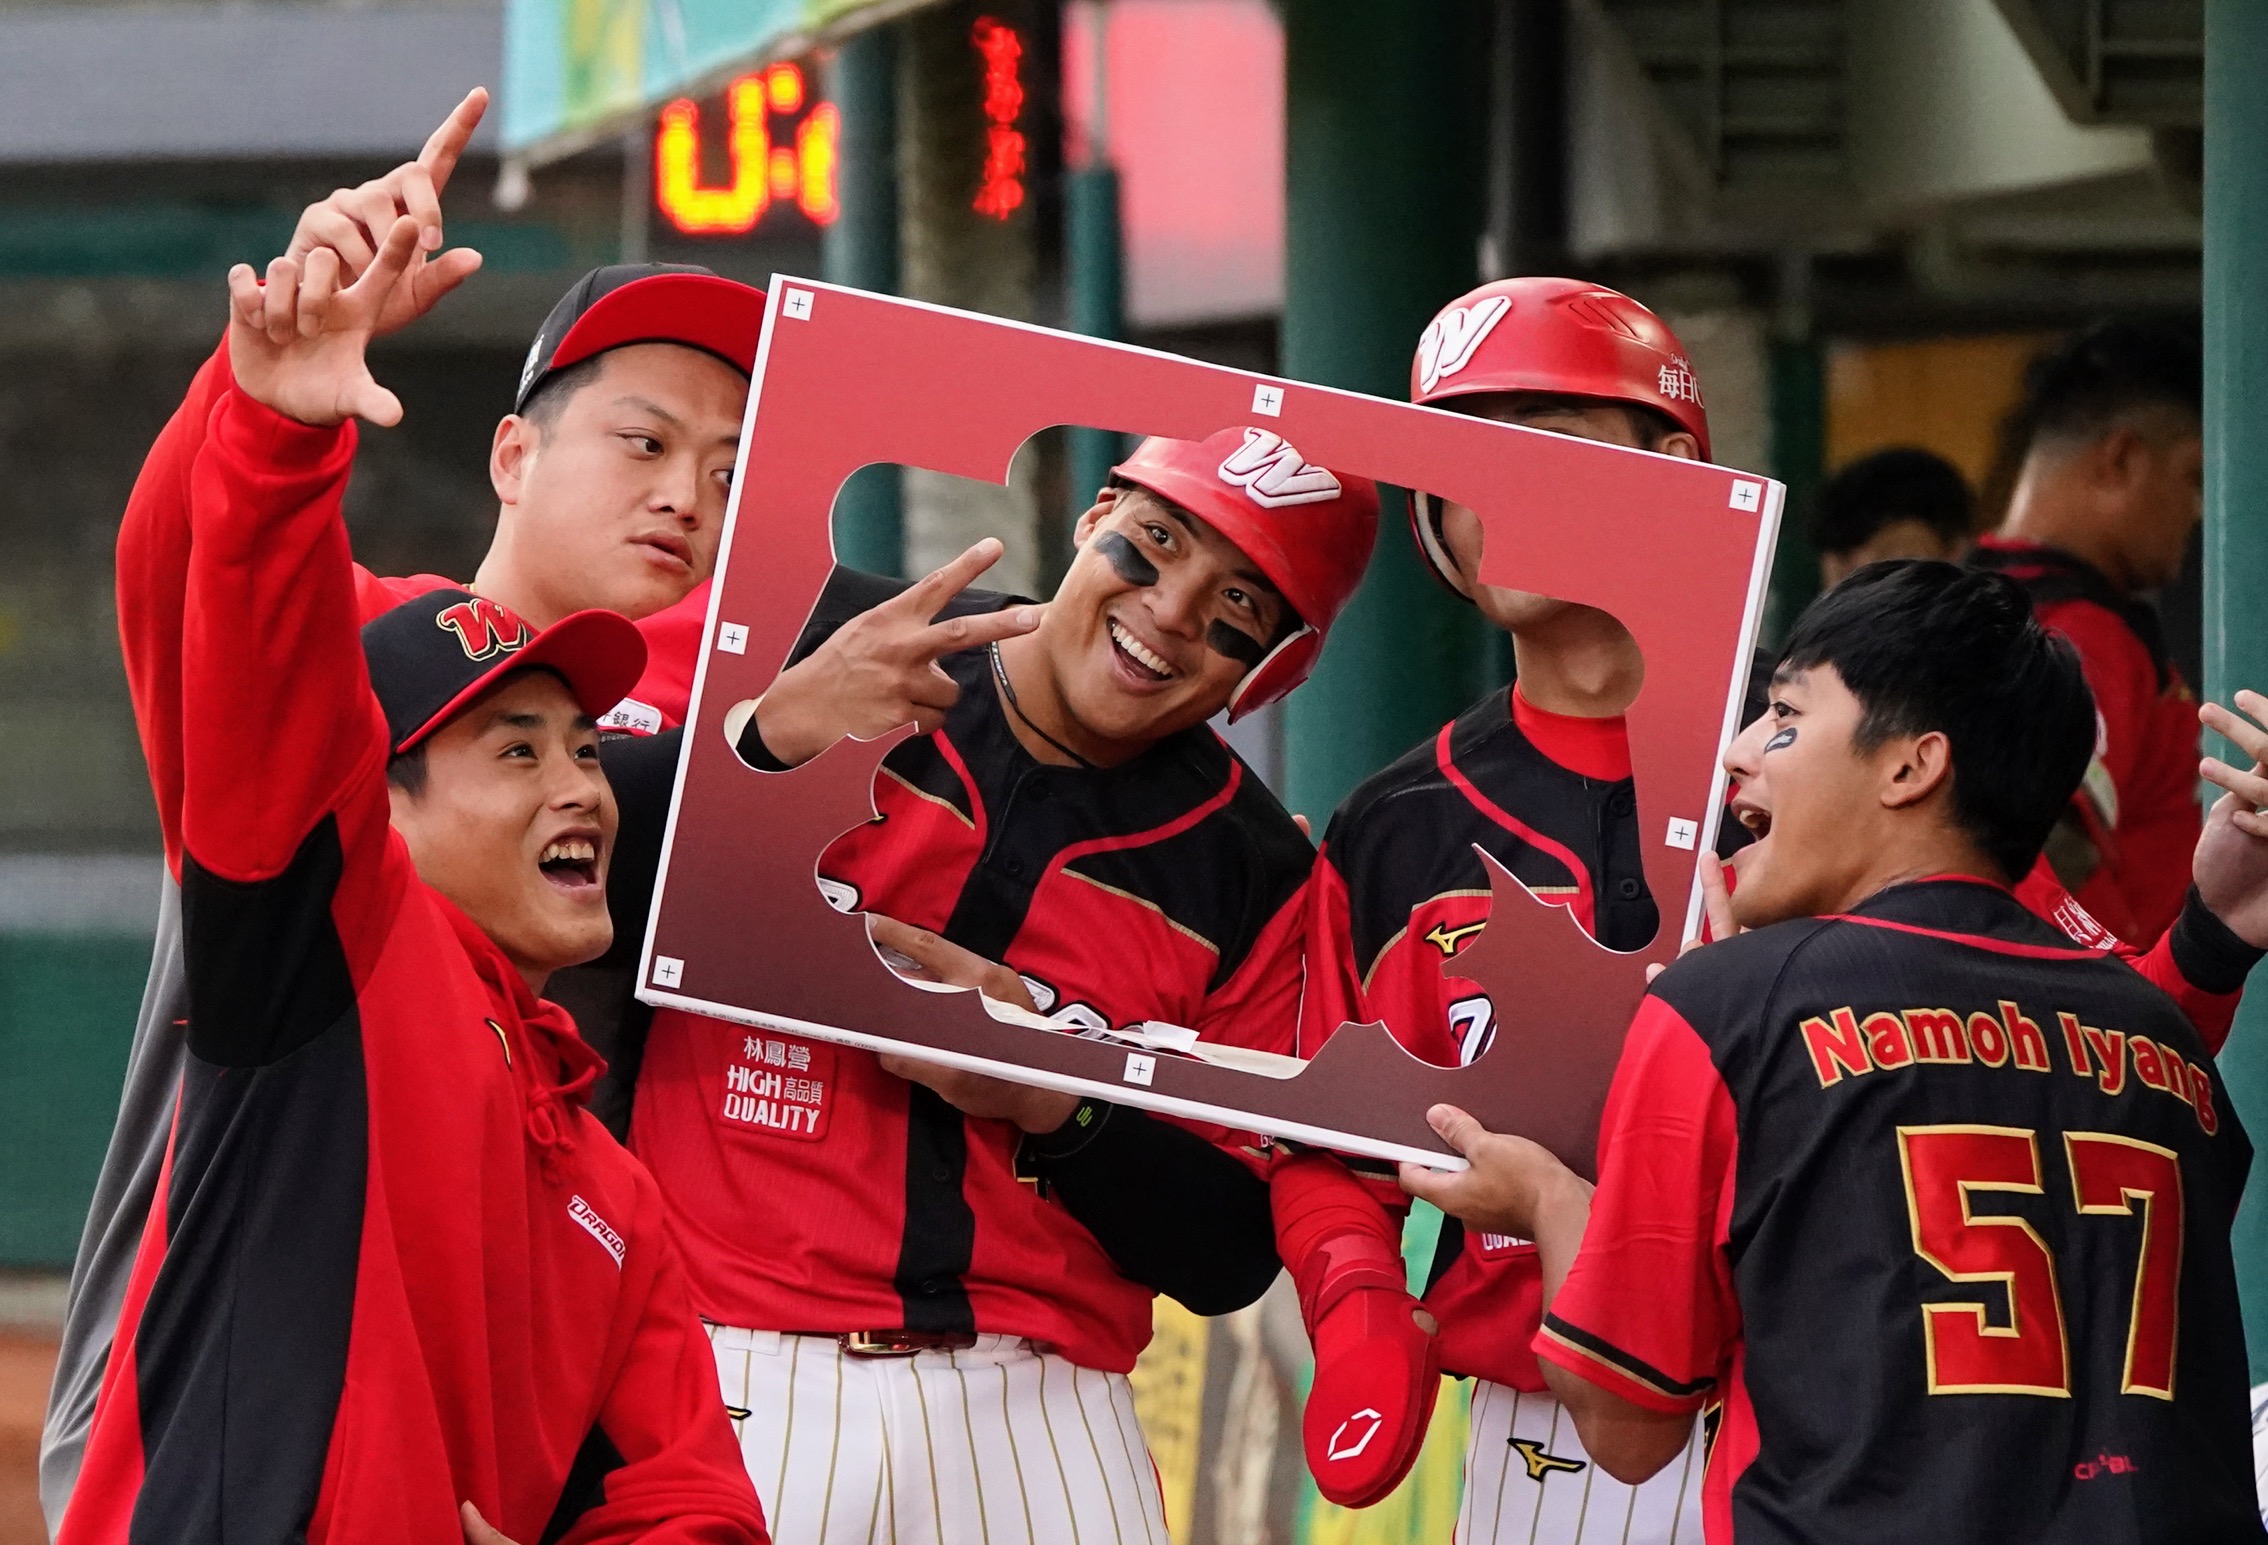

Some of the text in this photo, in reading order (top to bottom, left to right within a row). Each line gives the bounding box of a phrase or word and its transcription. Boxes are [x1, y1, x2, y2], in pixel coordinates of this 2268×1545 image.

[1218, 426, 1342, 509] W
[436, 598, 528, 662] W
[602, 710, 650, 731] 銀行
[743, 1035, 811, 1072] 林鳳營
[1800, 1000, 2219, 1136] Namoh Iyang
[727, 1064, 824, 1105] HIGH 高品質
[723, 1093, 820, 1133] QUALITY
[1896, 1124, 2185, 1402] 57
